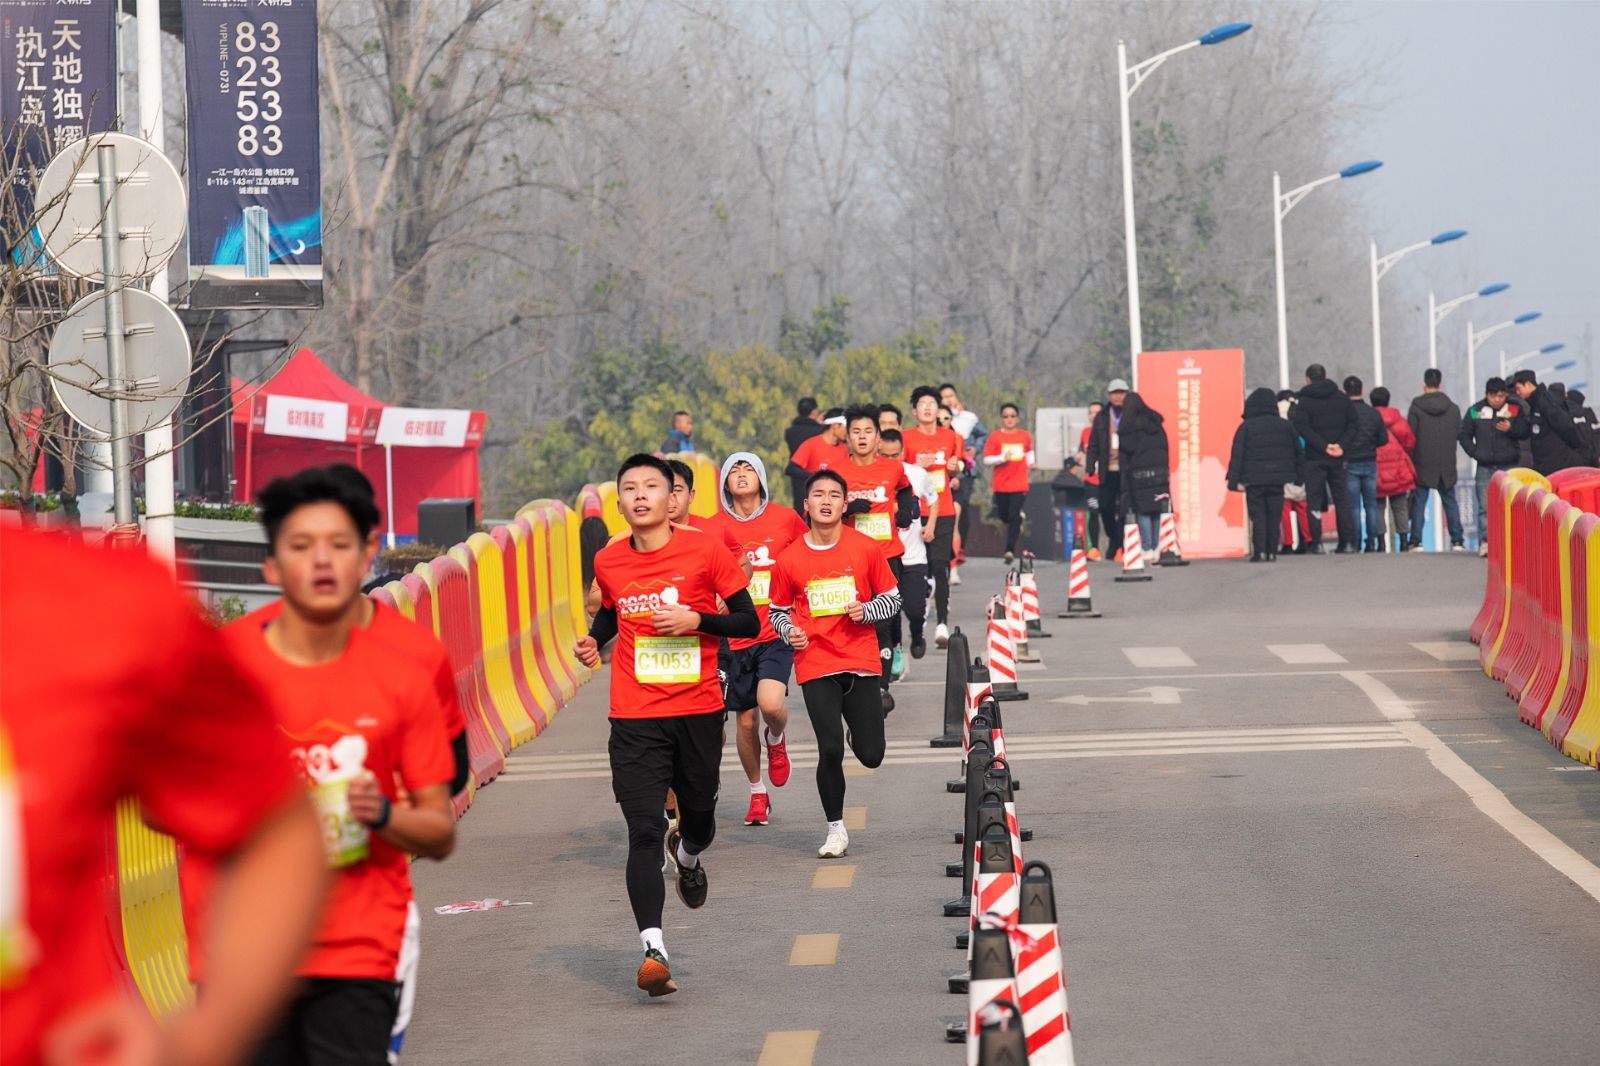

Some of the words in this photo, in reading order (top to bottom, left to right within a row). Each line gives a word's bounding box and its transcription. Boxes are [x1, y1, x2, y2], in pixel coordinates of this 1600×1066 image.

[236, 21, 281, 53] 83
[236, 56, 282, 87] 23
[236, 90, 283, 122] 53
[238, 124, 284, 156] 83
[810, 590, 852, 607] C1056
[638, 651, 692, 670] C1053
